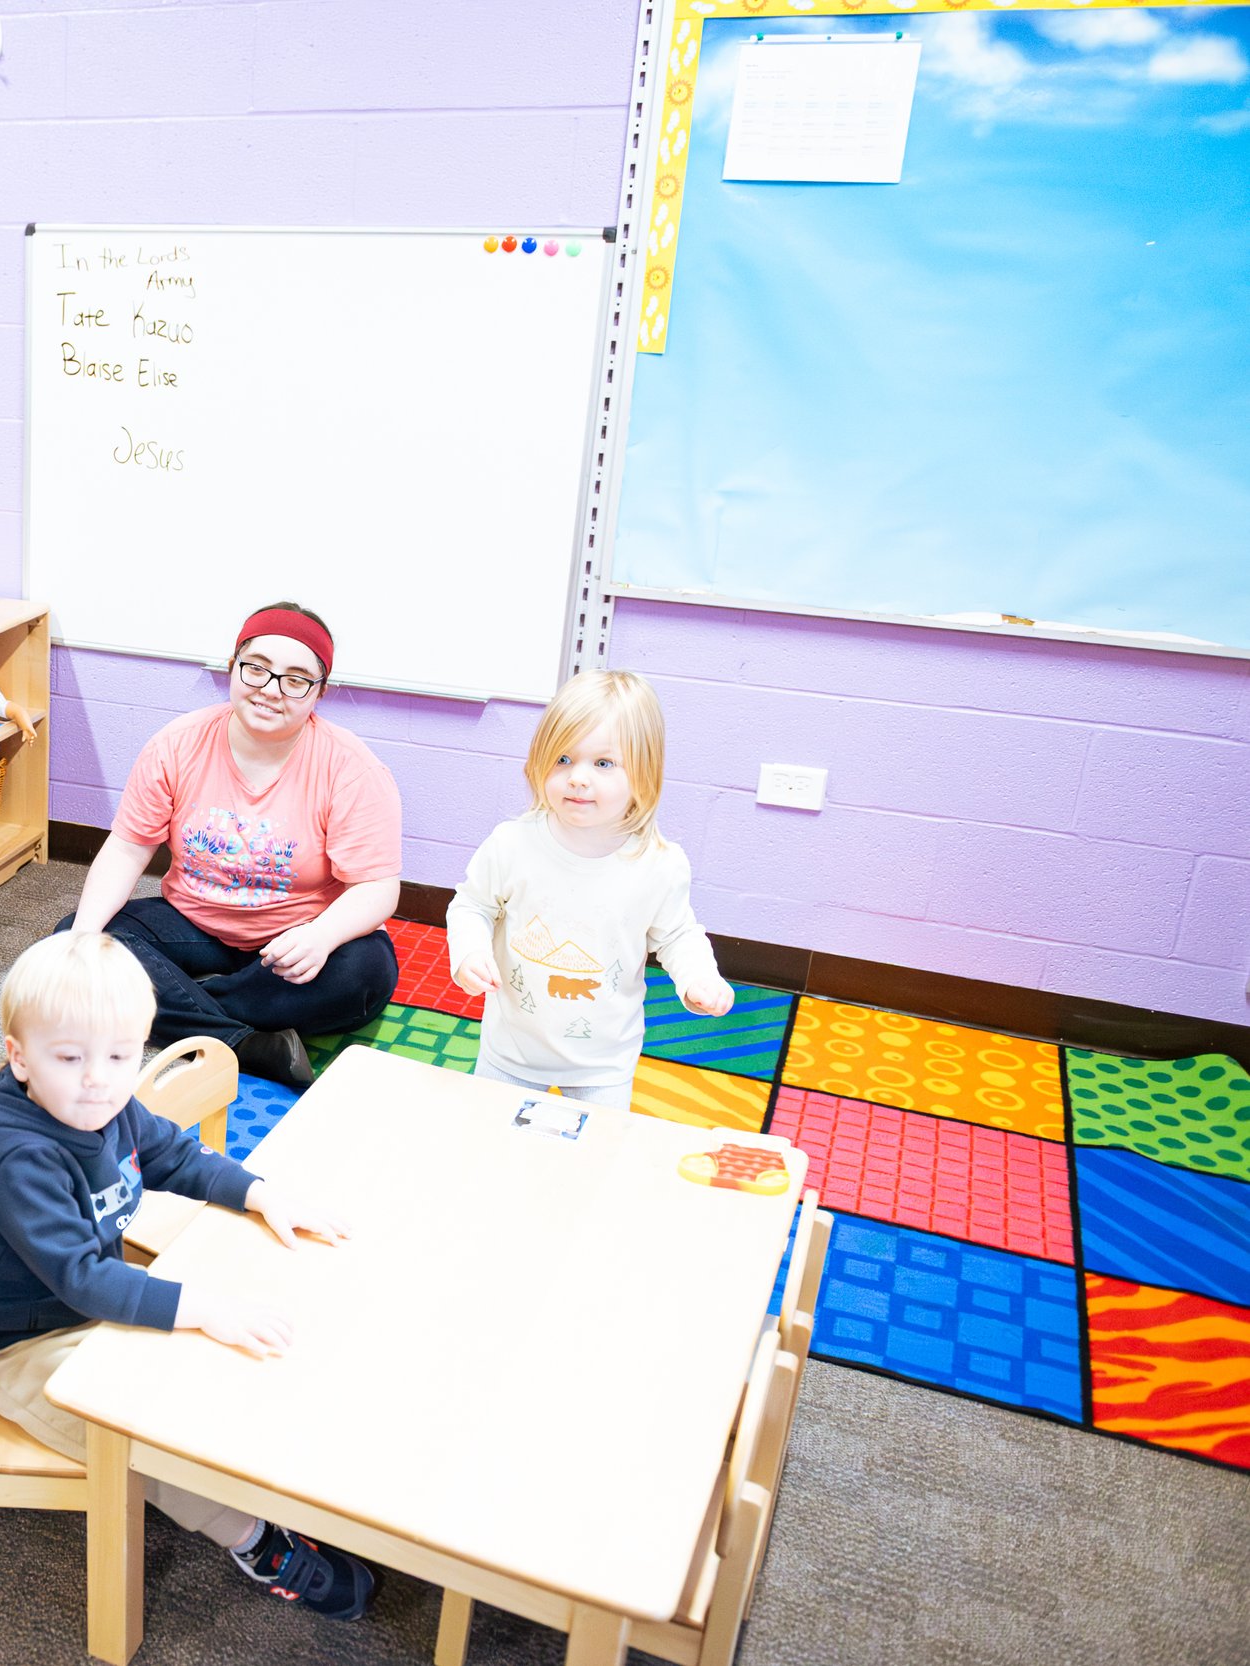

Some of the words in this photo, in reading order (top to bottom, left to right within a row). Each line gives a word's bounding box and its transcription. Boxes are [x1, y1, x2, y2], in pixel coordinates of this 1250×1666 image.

[53, 243, 89, 271] In
[99, 247, 128, 270] the
[146, 270, 196, 299] Army
[56, 291, 110, 328] Tate
[132, 301, 194, 344] Kazuo
[61, 342, 124, 382] Blaise
[138, 358, 178, 388] Elise
[113, 426, 185, 471] Jesus
